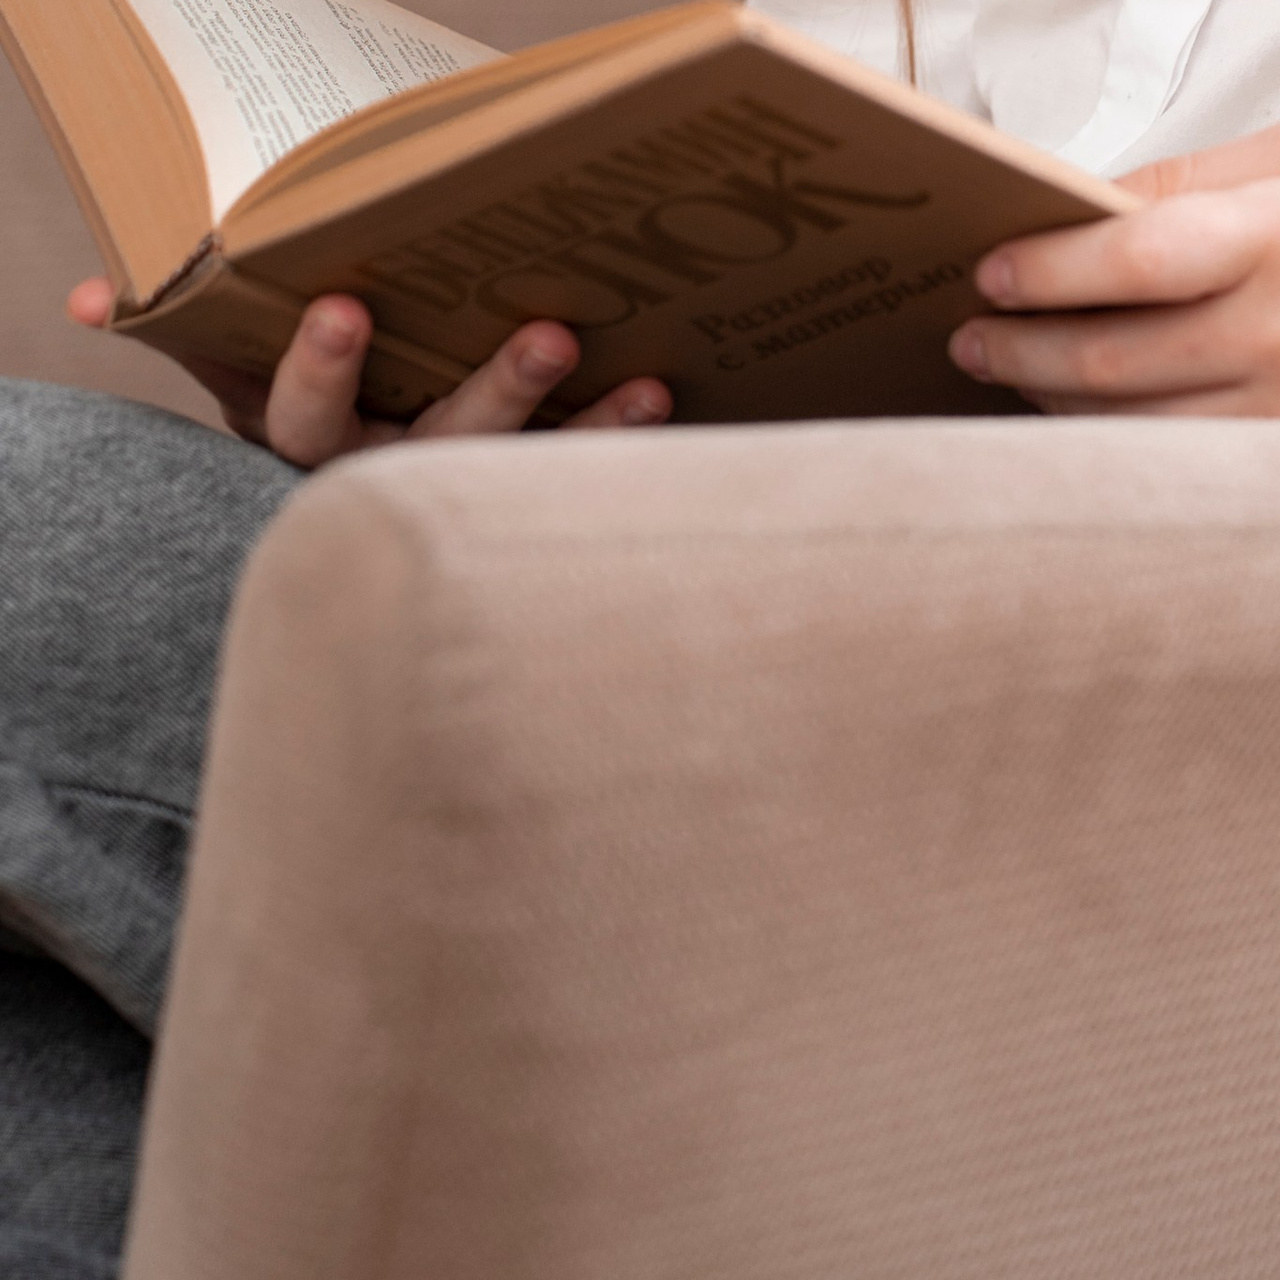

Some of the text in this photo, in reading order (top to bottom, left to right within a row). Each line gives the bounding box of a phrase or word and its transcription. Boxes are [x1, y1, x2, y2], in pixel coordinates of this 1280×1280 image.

[476, 153, 933, 328] СПОК
[690, 256, 894, 342] Разговор
[715, 260, 967, 373] с матерью
